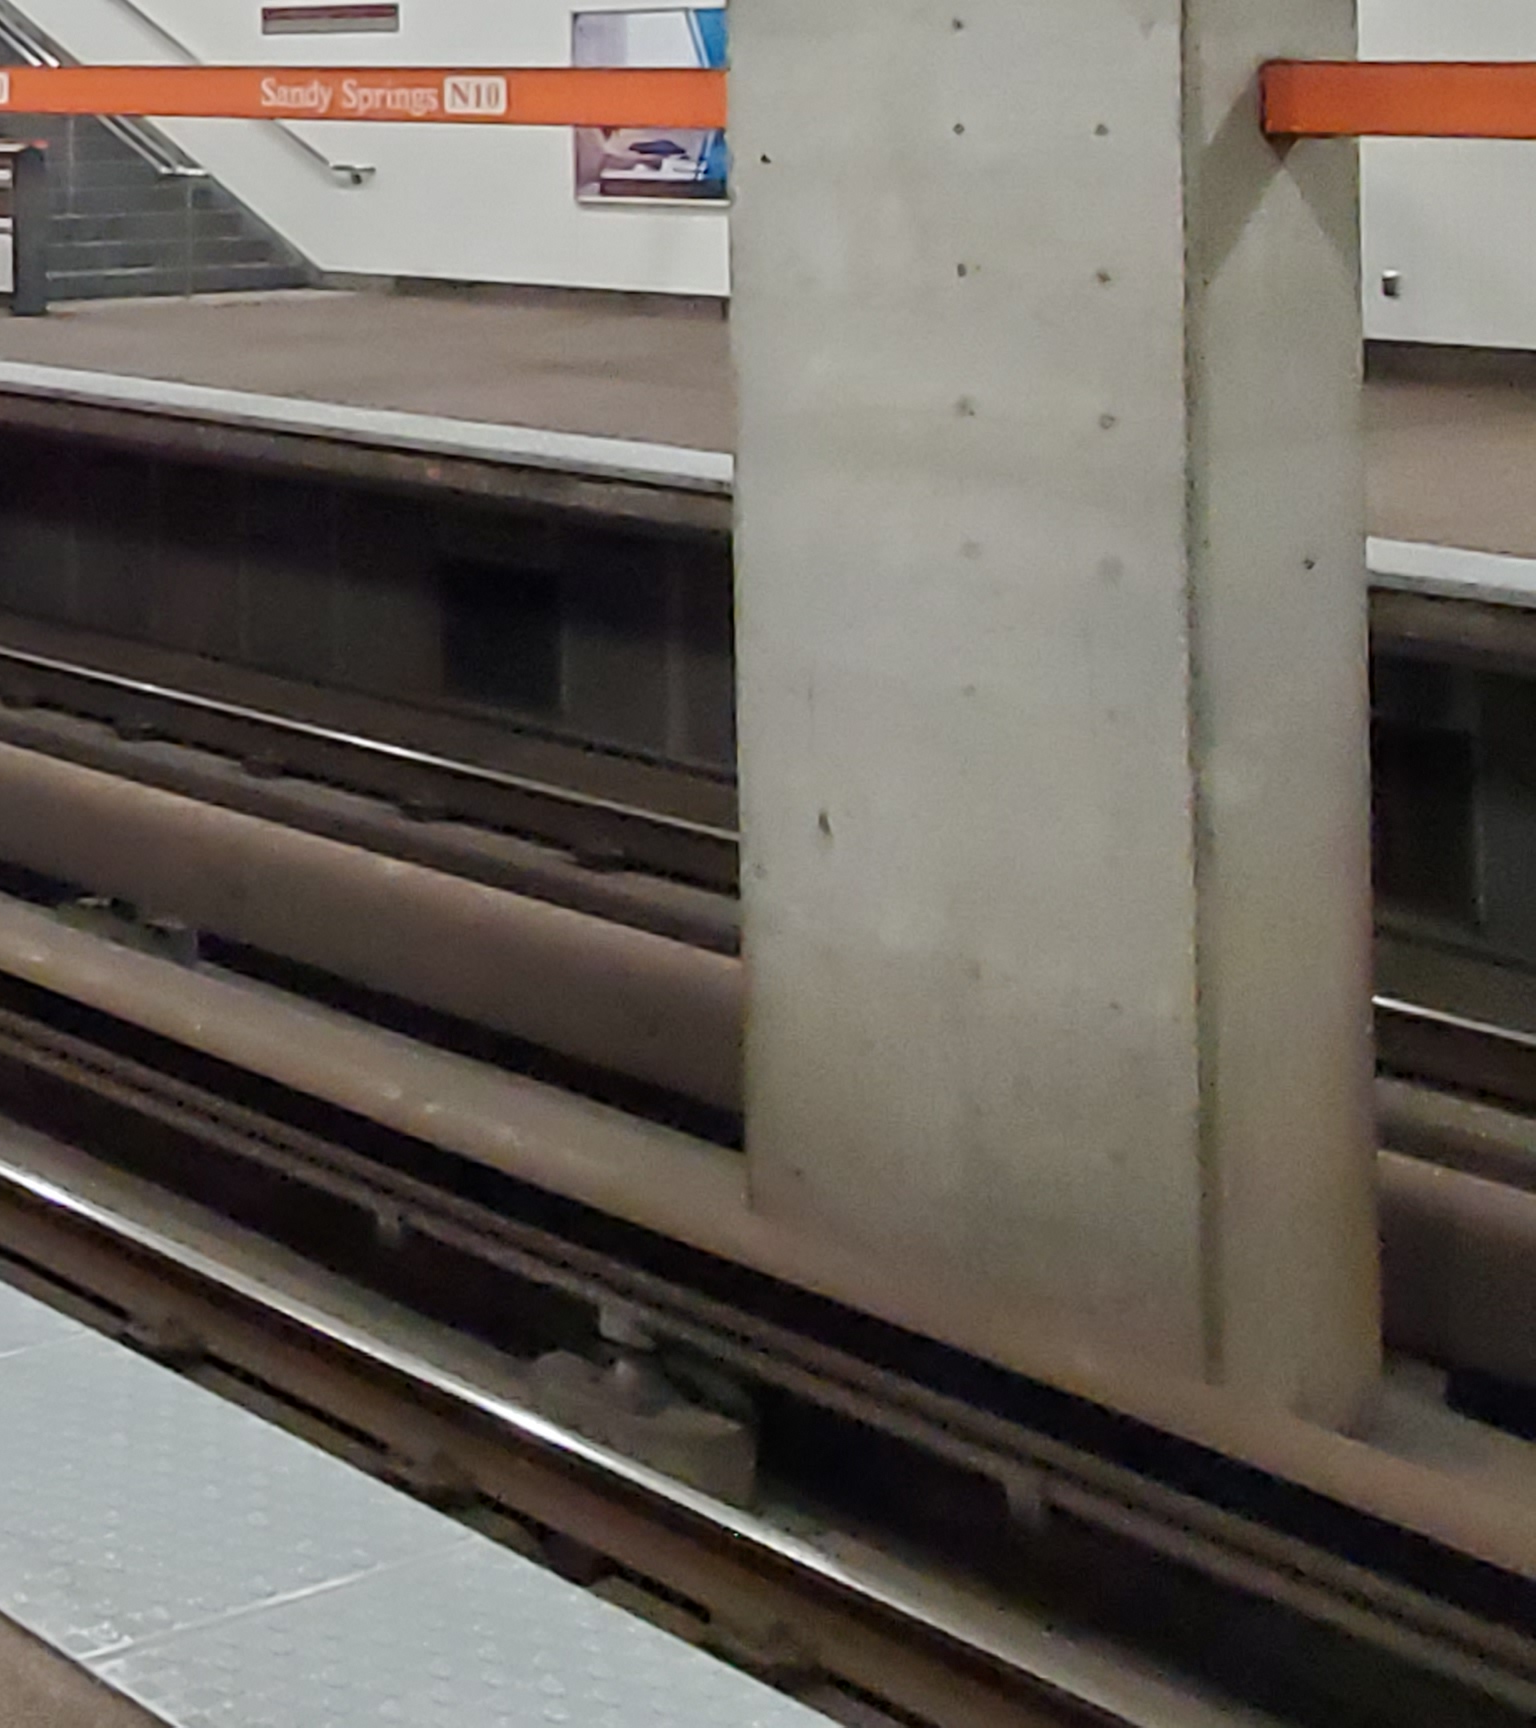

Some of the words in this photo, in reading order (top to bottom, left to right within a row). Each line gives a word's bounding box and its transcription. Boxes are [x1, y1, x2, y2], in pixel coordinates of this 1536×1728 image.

[261, 77, 332, 113] Sandy
[342, 79, 439, 116] Springs
[451, 82, 499, 108] N10
